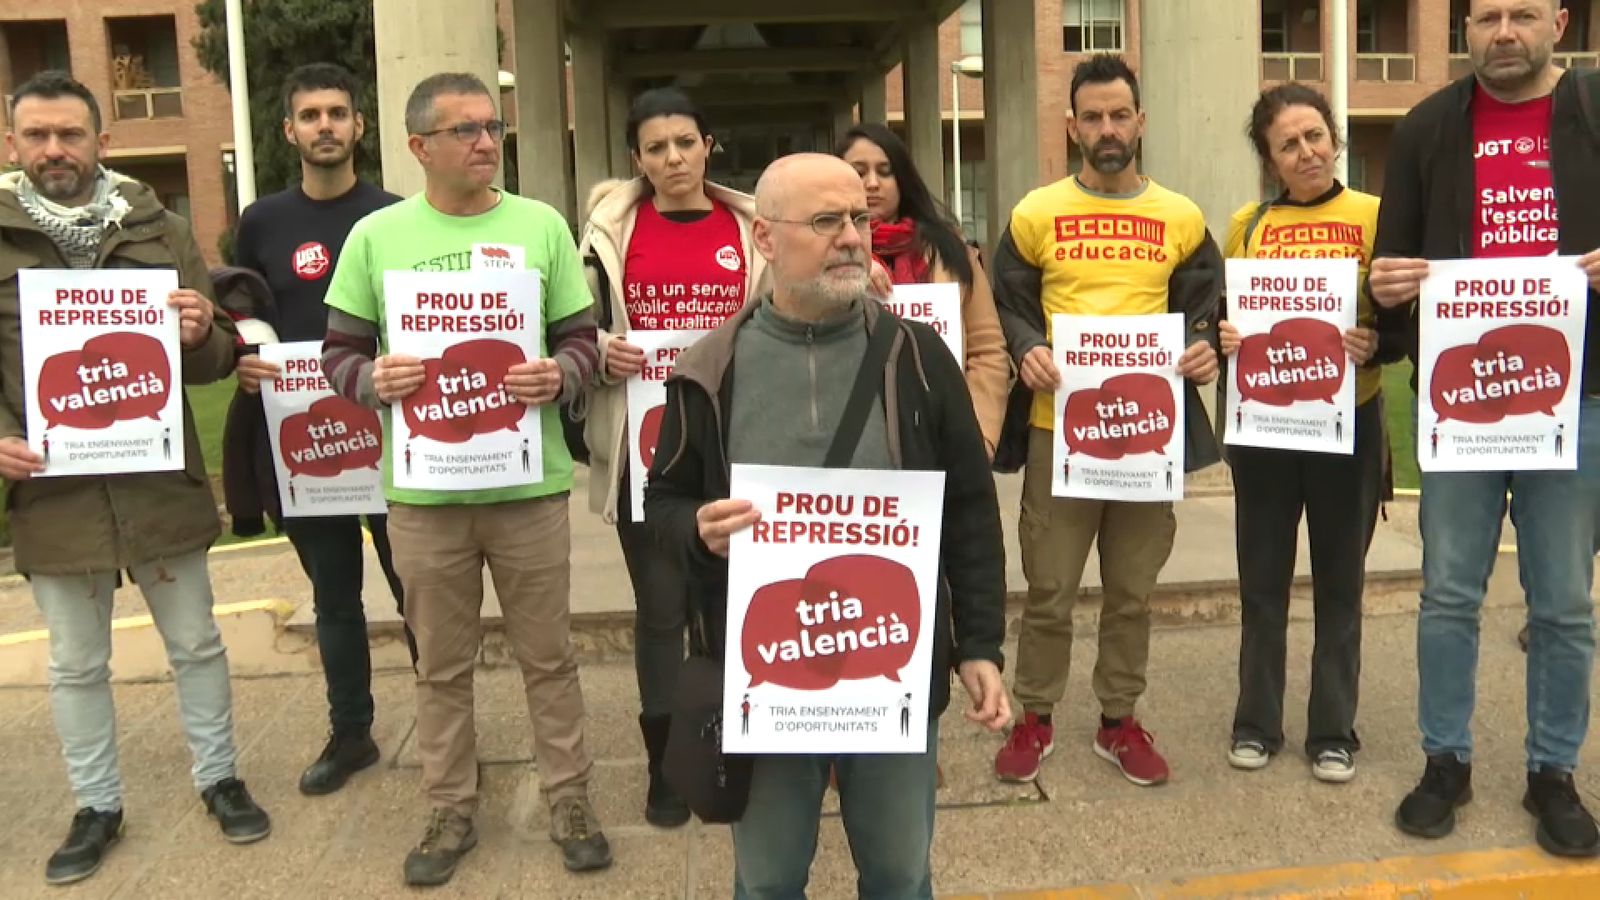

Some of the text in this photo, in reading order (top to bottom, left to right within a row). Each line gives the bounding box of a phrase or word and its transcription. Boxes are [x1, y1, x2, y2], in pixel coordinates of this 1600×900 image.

[1059, 219, 1133, 237] CCOO
[1481, 224, 1558, 248] pública
[646, 284, 656, 297] a
[662, 283, 686, 296] un
[1251, 276, 1328, 292] PROU DE
[1455, 278, 1552, 297] PROU DE
[56, 289, 147, 305] PROU DE
[416, 292, 508, 310] PROU DE
[1238, 293, 1342, 312] REPRESSIÓ!
[1436, 295, 1569, 319] REPRESSIÓ!
[38, 304, 165, 326] REPRESSIÓ!
[401, 309, 525, 332] REPRESSIÓ!
[911, 302, 933, 318] DE
[1079, 332, 1159, 348] PROU DE
[1066, 347, 1173, 367] REPRESSIÓ!
[1265, 342, 1307, 364] tria
[1471, 351, 1524, 377] tria
[76, 357, 129, 384] tria
[436, 367, 487, 395] tria
[1245, 356, 1339, 388] valencià
[50, 371, 165, 413] valencià
[1442, 364, 1561, 406] valencià
[1095, 397, 1139, 419] tria
[307, 418, 348, 440] tria
[1073, 409, 1170, 441] valencià
[64, 440, 85, 449] TRIA
[290, 427, 379, 464] valencià
[1452, 434, 1545, 445] TRIA ENSENYAMENT
[423, 451, 513, 463] TRIA ENSENYAMENT
[776, 491, 899, 518] PROU DE
[752, 519, 920, 547] REPRESSIÓ!
[795, 591, 863, 626] tria
[757, 612, 910, 665] valencià
[769, 706, 889, 717] TRIA ENSENYAMENT
[774, 721, 878, 733] D'OPORTUNITATS
